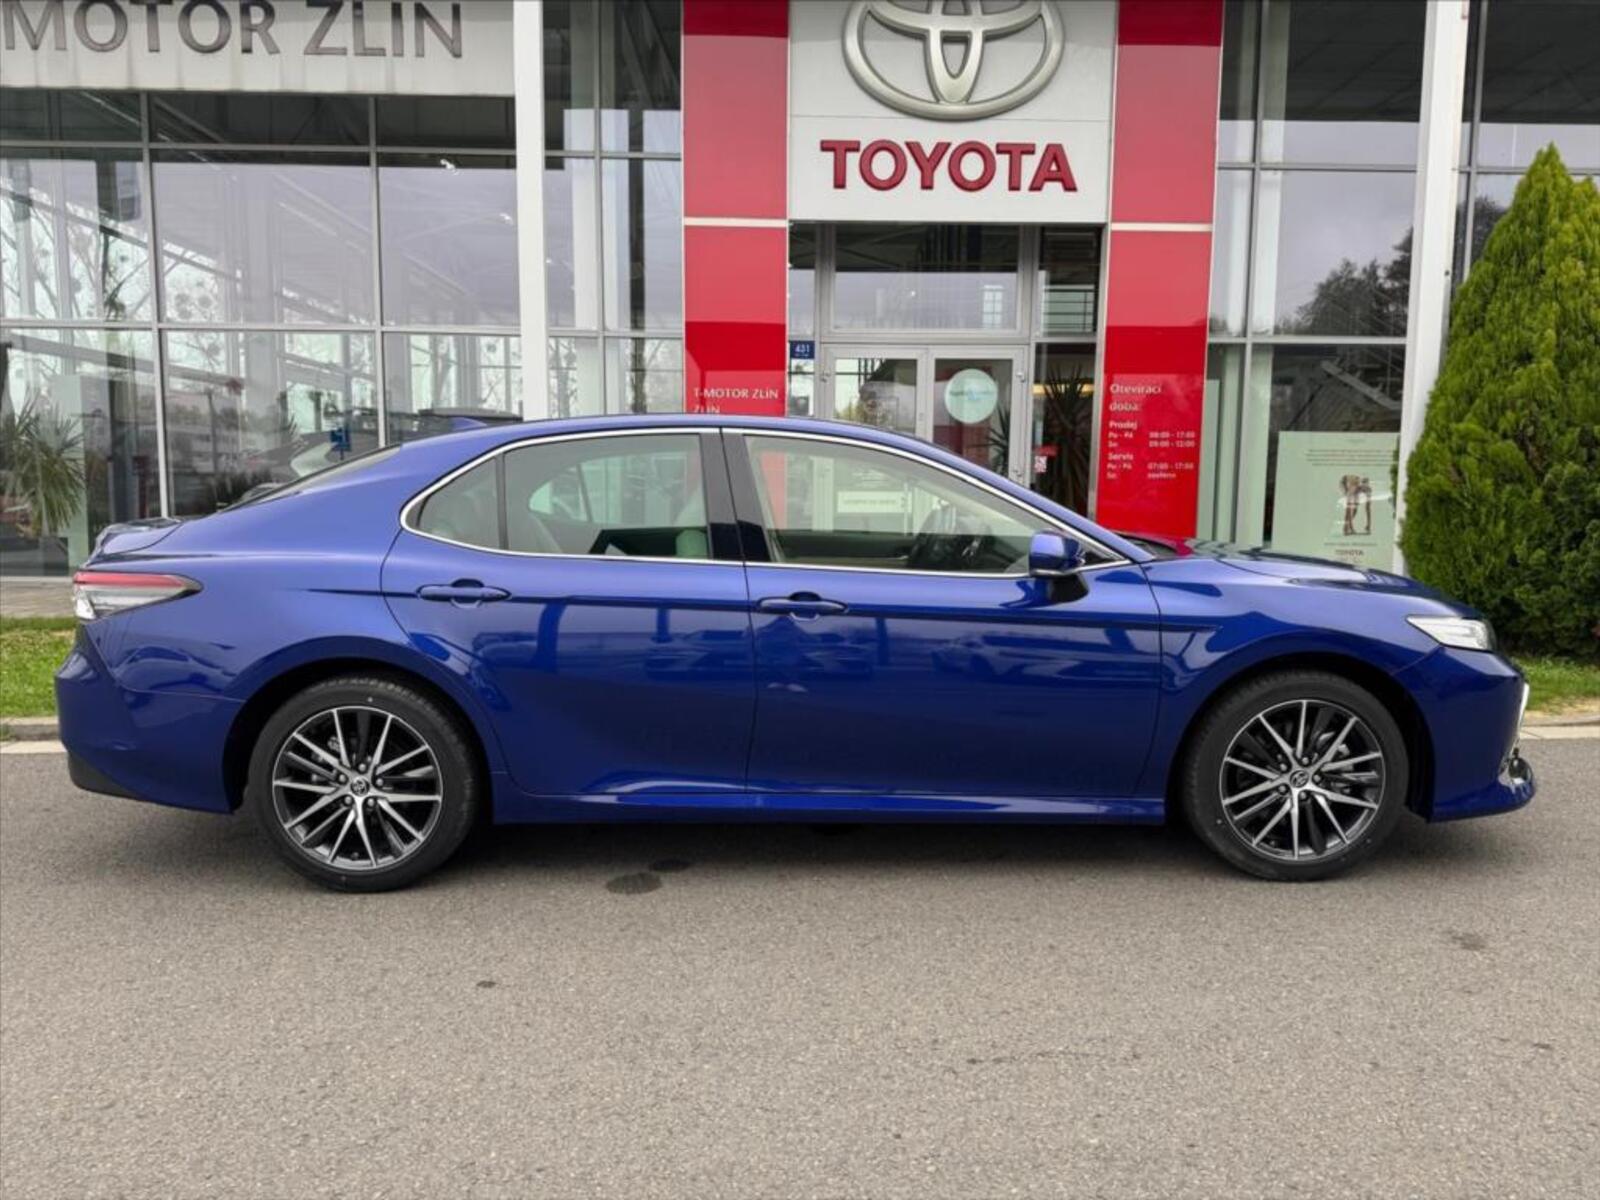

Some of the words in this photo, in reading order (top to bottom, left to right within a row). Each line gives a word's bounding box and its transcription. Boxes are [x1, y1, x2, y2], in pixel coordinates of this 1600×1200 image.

[2, 0, 281, 55] MOTOR
[820, 138, 1078, 192] TOYOTA
[694, 387, 749, 399] T-MOTOR
